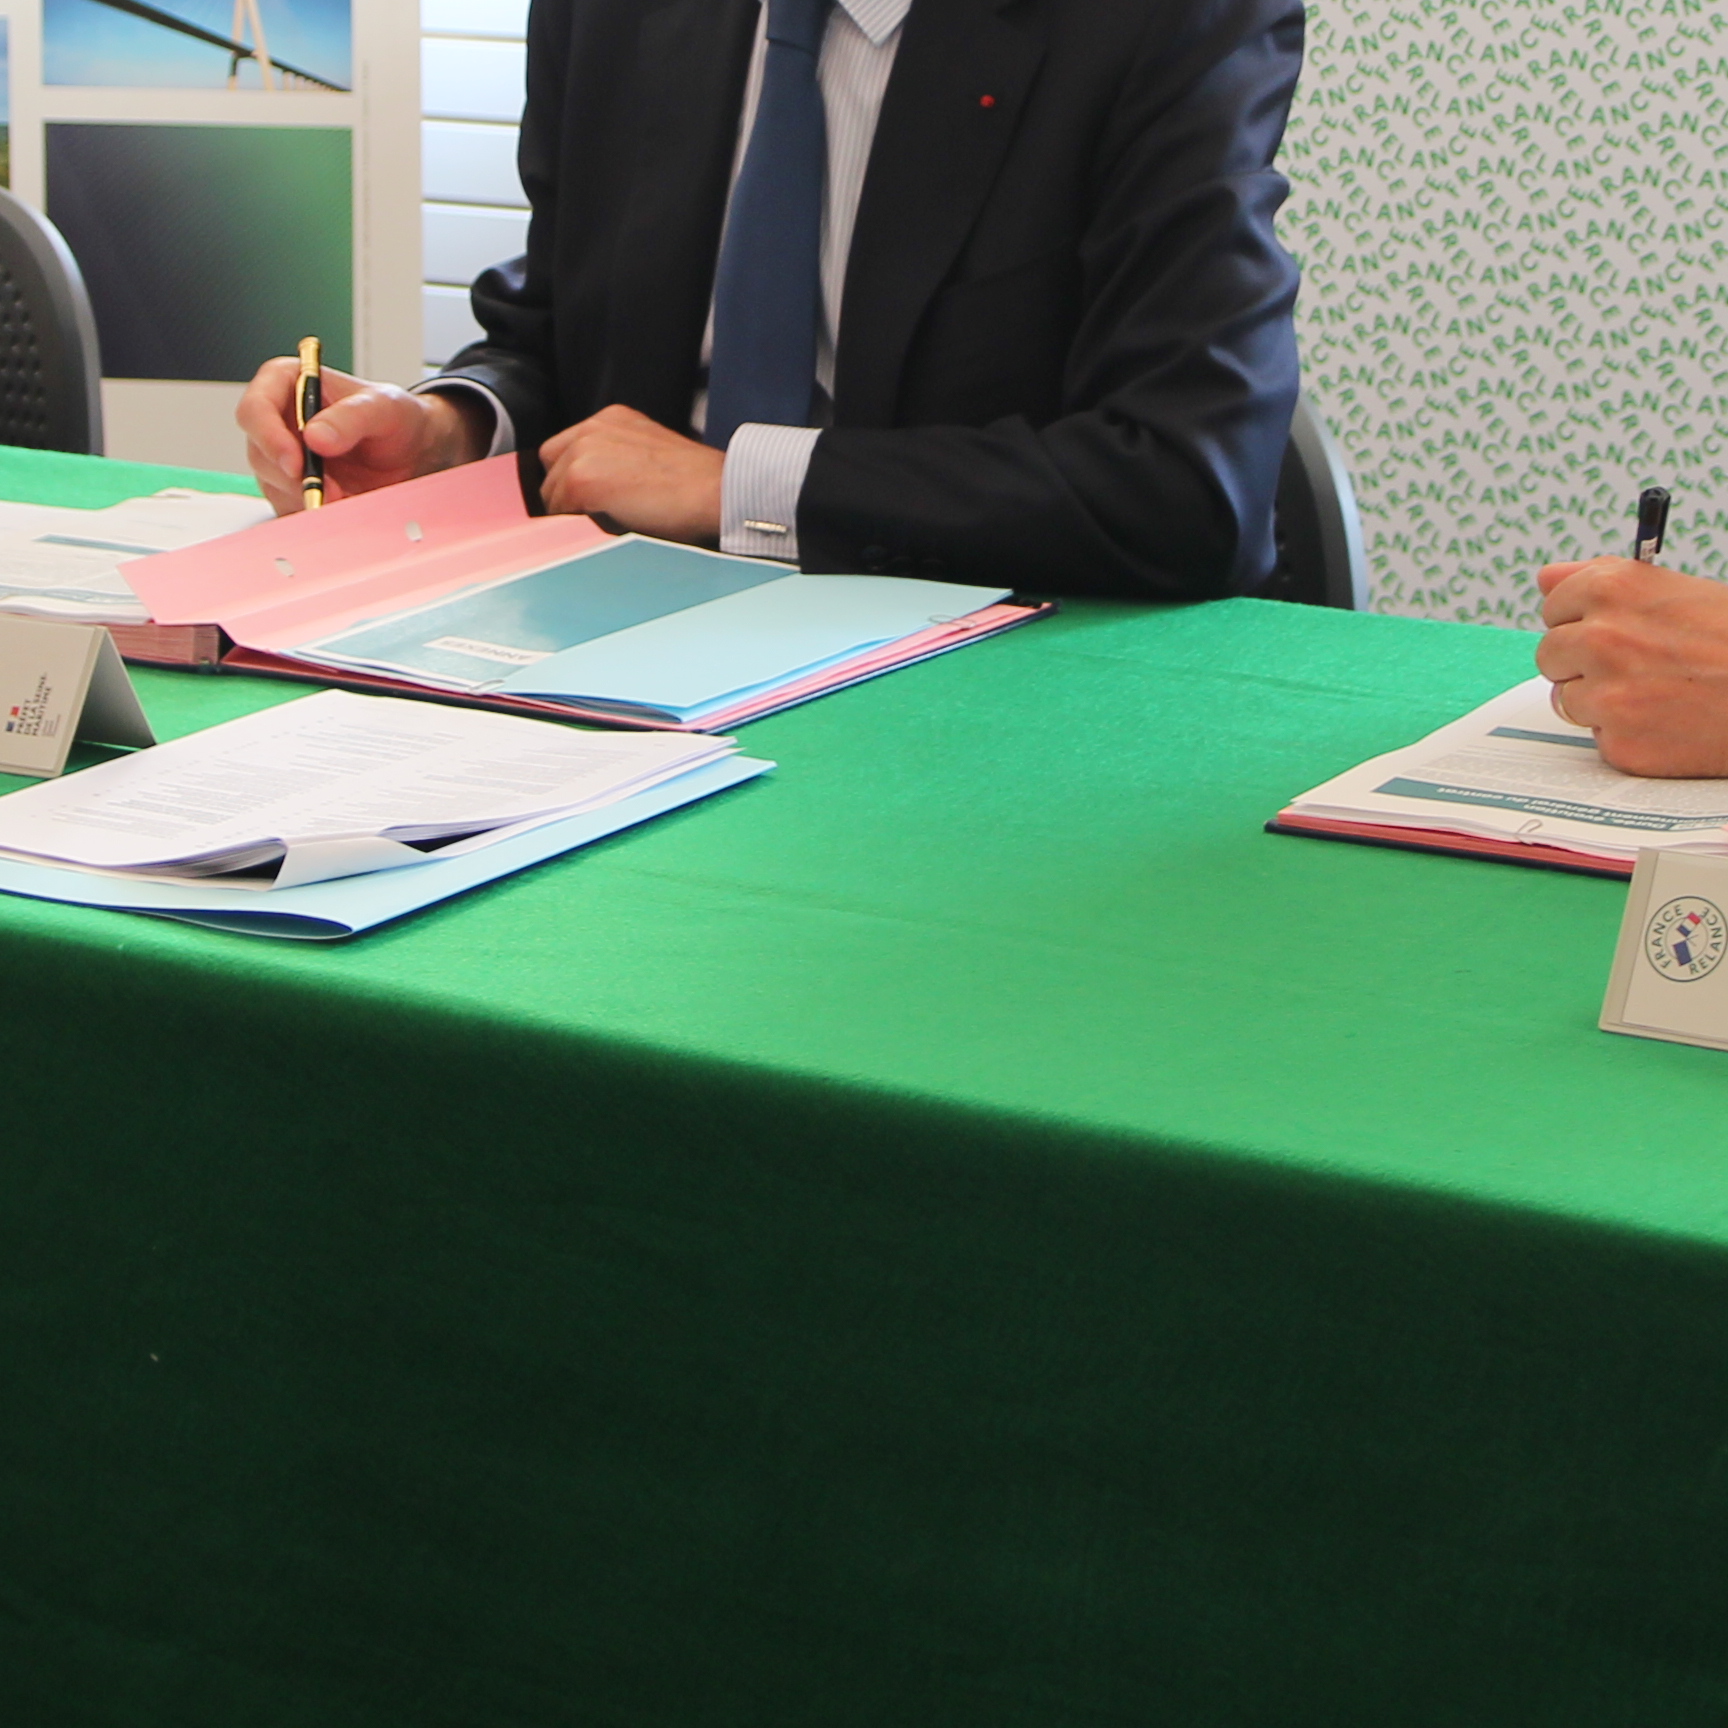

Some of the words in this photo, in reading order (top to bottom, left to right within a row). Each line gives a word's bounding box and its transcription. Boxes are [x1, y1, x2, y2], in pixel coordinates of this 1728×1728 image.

[1583, 19, 1695, 73] RELANCE
[1340, 94, 1443, 143] FRANCE
[1371, 118, 1478, 171] RELANCE
[1445, 156, 1550, 206] FRANCE
[1476, 180, 1585, 234] RELANCE
[1552, 219, 1659, 270] FRANCE
[1583, 243, 1695, 298] RELANCE
[1341, 314, 1444, 364] FRANCE
[1371, 337, 1478, 391] RELANCE
[1445, 378, 1550, 429] FRANCE
[1476, 401, 1585, 456] RELANCE
[1436, 785, 1504, 801] contrat
[1506, 794, 1531, 804] du
[1522, 802, 1606, 823] évolution
[1531, 797, 1601, 817] général
[1651, 904, 1684, 970] FRANCE
[1688, 906, 1724, 976] RELANCE
